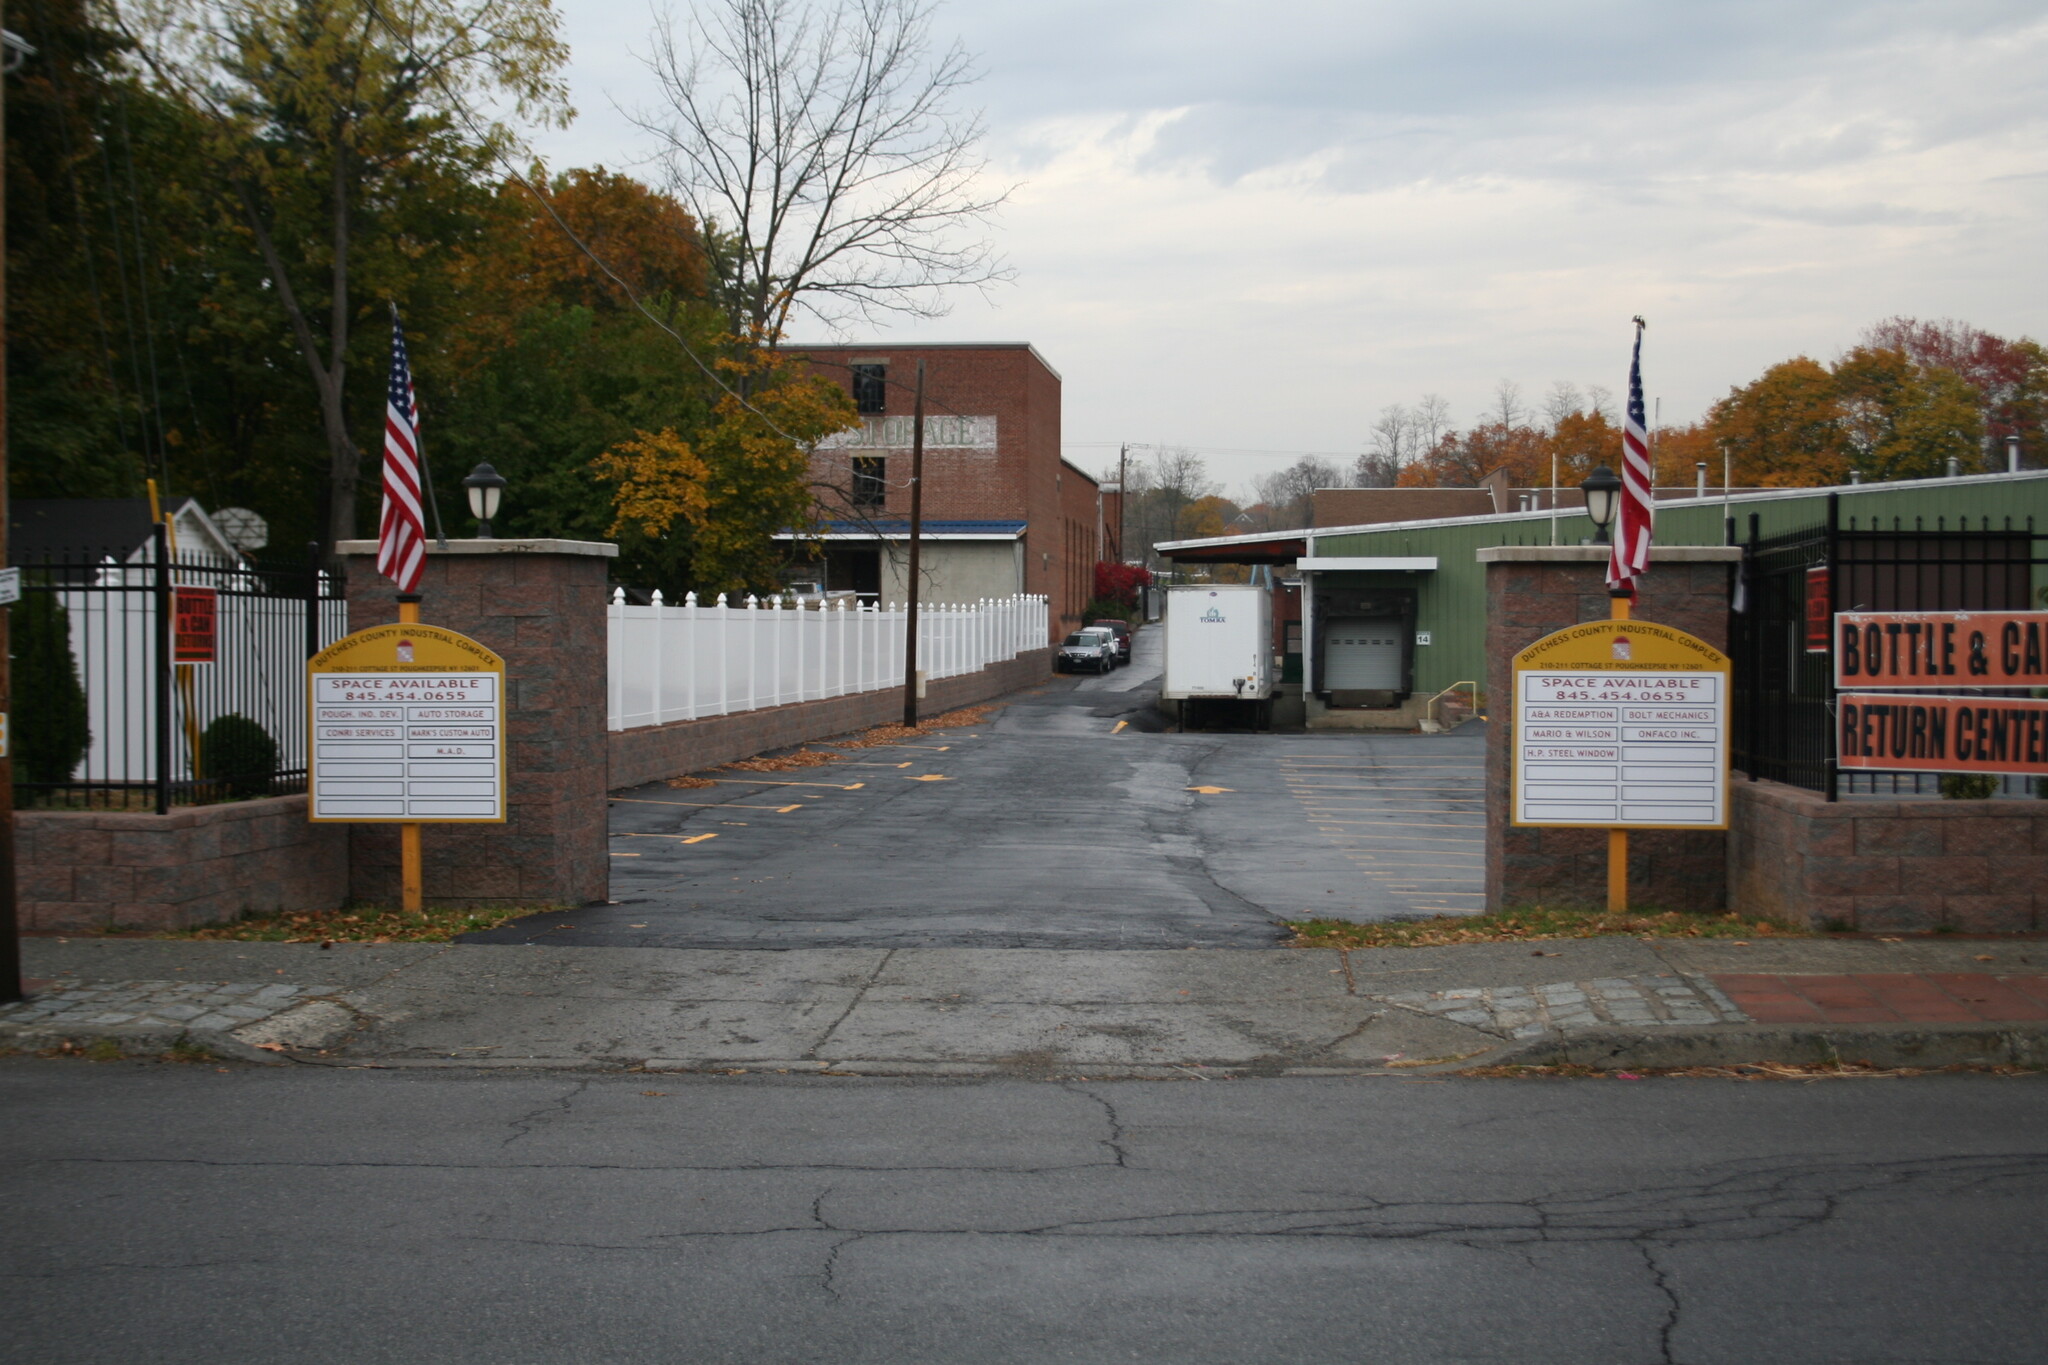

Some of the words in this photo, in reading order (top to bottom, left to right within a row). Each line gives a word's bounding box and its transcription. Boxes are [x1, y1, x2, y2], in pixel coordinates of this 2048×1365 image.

[315, 638, 358, 667] DUTCHESS
[360, 630, 397, 642] COUNTY
[401, 629, 452, 645] INDUSTRIAL
[456, 640, 496, 666] COMPLEX
[1522, 634, 1569, 662] DUTCHESS
[1572, 626, 1613, 639] COUNTY
[1617, 625, 1674, 641] INDUSTRIAL
[1678, 637, 1721, 664] COMPLEX
[1842, 623, 1955, 677] BOTTLE
[1968, 630, 1988, 675] &
[2002, 621, 2048, 676] CA
[332, 680, 382, 688] SPACE
[389, 680, 480, 688] AVAILABLE
[1542, 678, 1596, 688] SPACE
[1603, 679, 1700, 688] AVAILABLE
[346, 692, 466, 700] 845.454.0655
[1556, 691, 1685, 701] 845.454.0655
[1629, 711, 1652, 719] BOLT
[1656, 711, 1709, 720] MECHANICS
[1533, 730, 1562, 738] MARIO
[1576, 730, 1611, 738] WILSON
[1843, 704, 1947, 759] RETURN
[1528, 749, 1544, 757] H.P.
